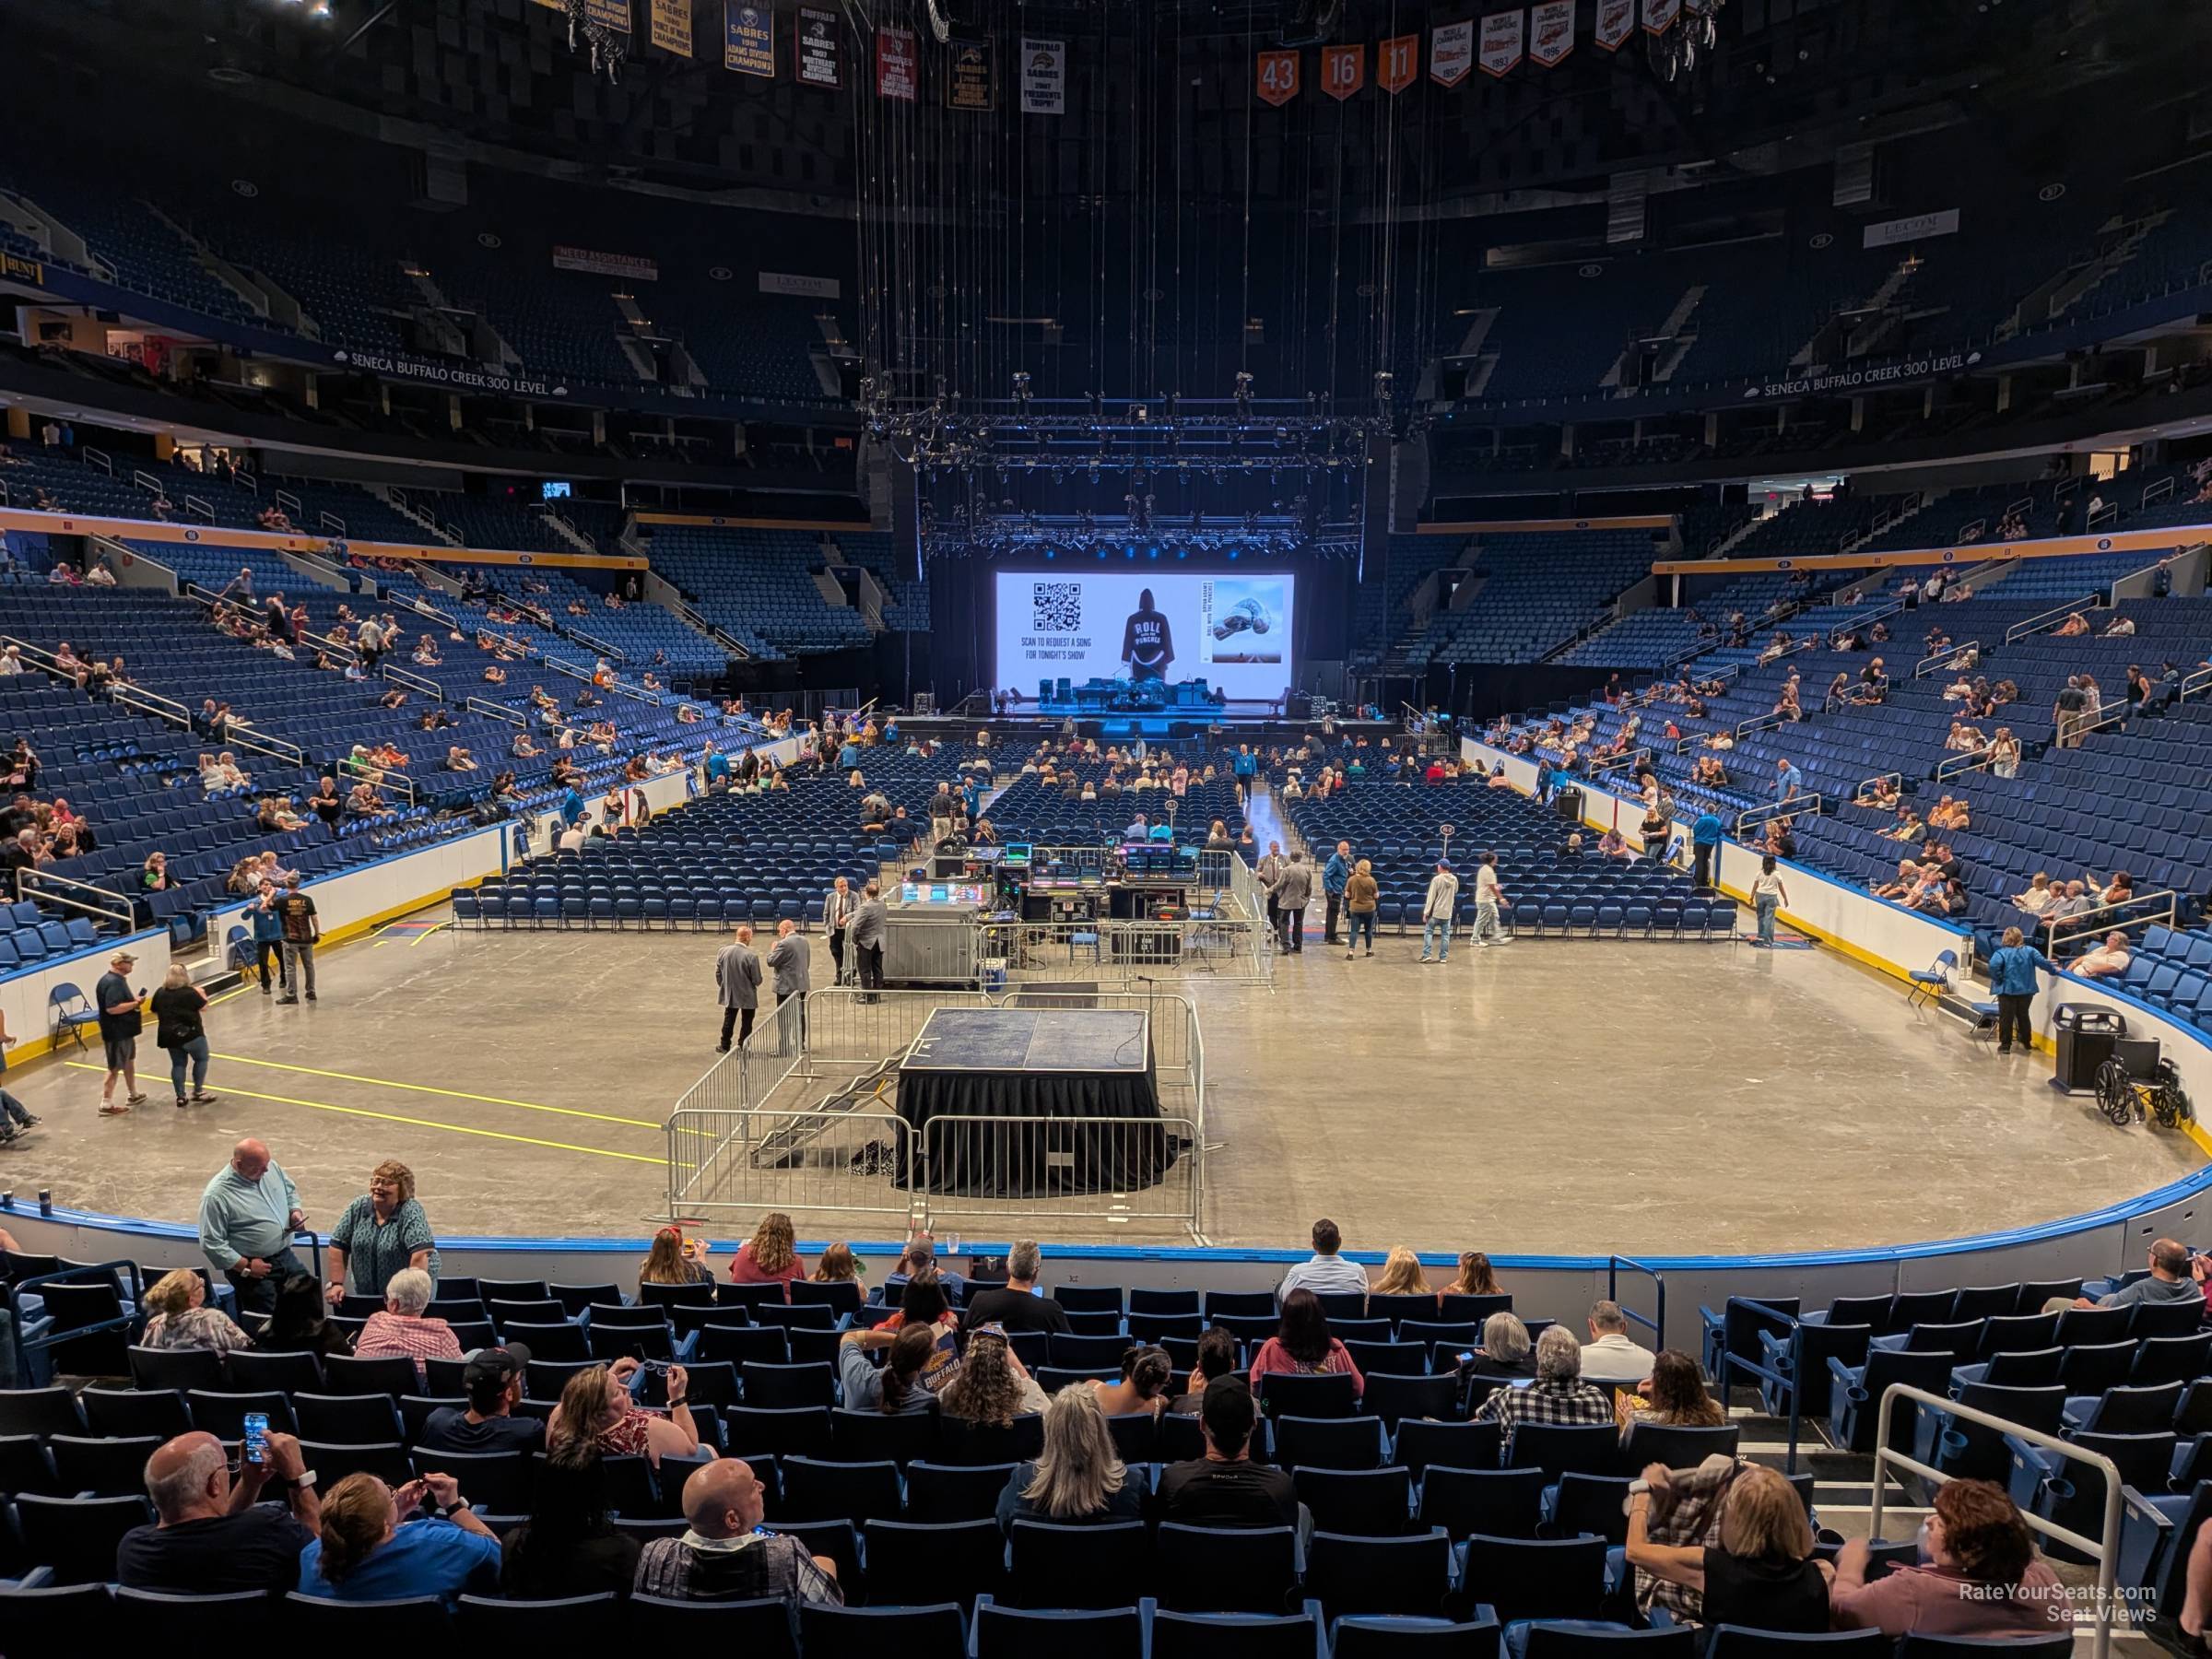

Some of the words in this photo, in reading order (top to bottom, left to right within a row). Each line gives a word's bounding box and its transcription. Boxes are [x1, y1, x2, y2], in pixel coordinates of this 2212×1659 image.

[655, 1, 688, 19] SABRES
[800, 7, 836, 22] BUFFALO
[1536, 10, 1570, 23] CHAMPIONS
[1544, 5, 1563, 14] WORLD
[1486, 21, 1517, 33] CHAMPIONS
[1492, 16, 1512, 24] WORLD
[730, 24, 769, 41] SABRES
[1437, 32, 1466, 44] CHAMPIONS
[653, 31, 690, 51] CHAMPIONS
[802, 35, 836, 51] SABRES
[1026, 41, 1060, 52] BUFFALO
[728, 44, 747, 56] ADAMS
[748, 49, 771, 61] DIVISION
[1543, 46, 1559, 57] 1996
[728, 54, 771, 71] CHAMPIONS
[1330, 53, 1356, 85] 16
[1388, 45, 1408, 78] 11
[1492, 57, 1509, 67] 1993
[802, 69, 838, 84] CHAMPIONS
[1027, 69, 1059, 78] SABRES
[1262, 59, 1294, 89] 43
[1443, 67, 1459, 77] 1992
[559, 246, 587, 259] NEED
[589, 251, 652, 267] ASSISTANCE?
[6, 256, 35, 276] HUNT
[352, 352, 394, 372] SENECA
[397, 360, 448, 382] BUFFALO
[451, 370, 486, 387] CREEK
[487, 376, 510, 391] 300
[513, 380, 549, 395] LEVEL
[1764, 381, 1810, 396] SENECA
[1813, 371, 1862, 391] BUFFALO
[1865, 364, 1901, 383] CREEK
[1902, 360, 1928, 378] 300
[1932, 354, 1964, 372] LEVEL
[1135, 621, 1160, 634] ROLL
[1021, 637, 1036, 646] SCAN
[1038, 637, 1044, 647] TO
[1046, 638, 1070, 647] REQUEST
[1070, 638, 1076, 647] A
[1077, 638, 1091, 647] SONG
[1135, 636, 1161, 645] PUNCHES
[1026, 650, 1036, 659] FOR
[1039, 650, 1066, 660] TONIGHT'S
[1067, 650, 1086, 660] SHOW
[924, 1358, 960, 1389] BUFFALO
